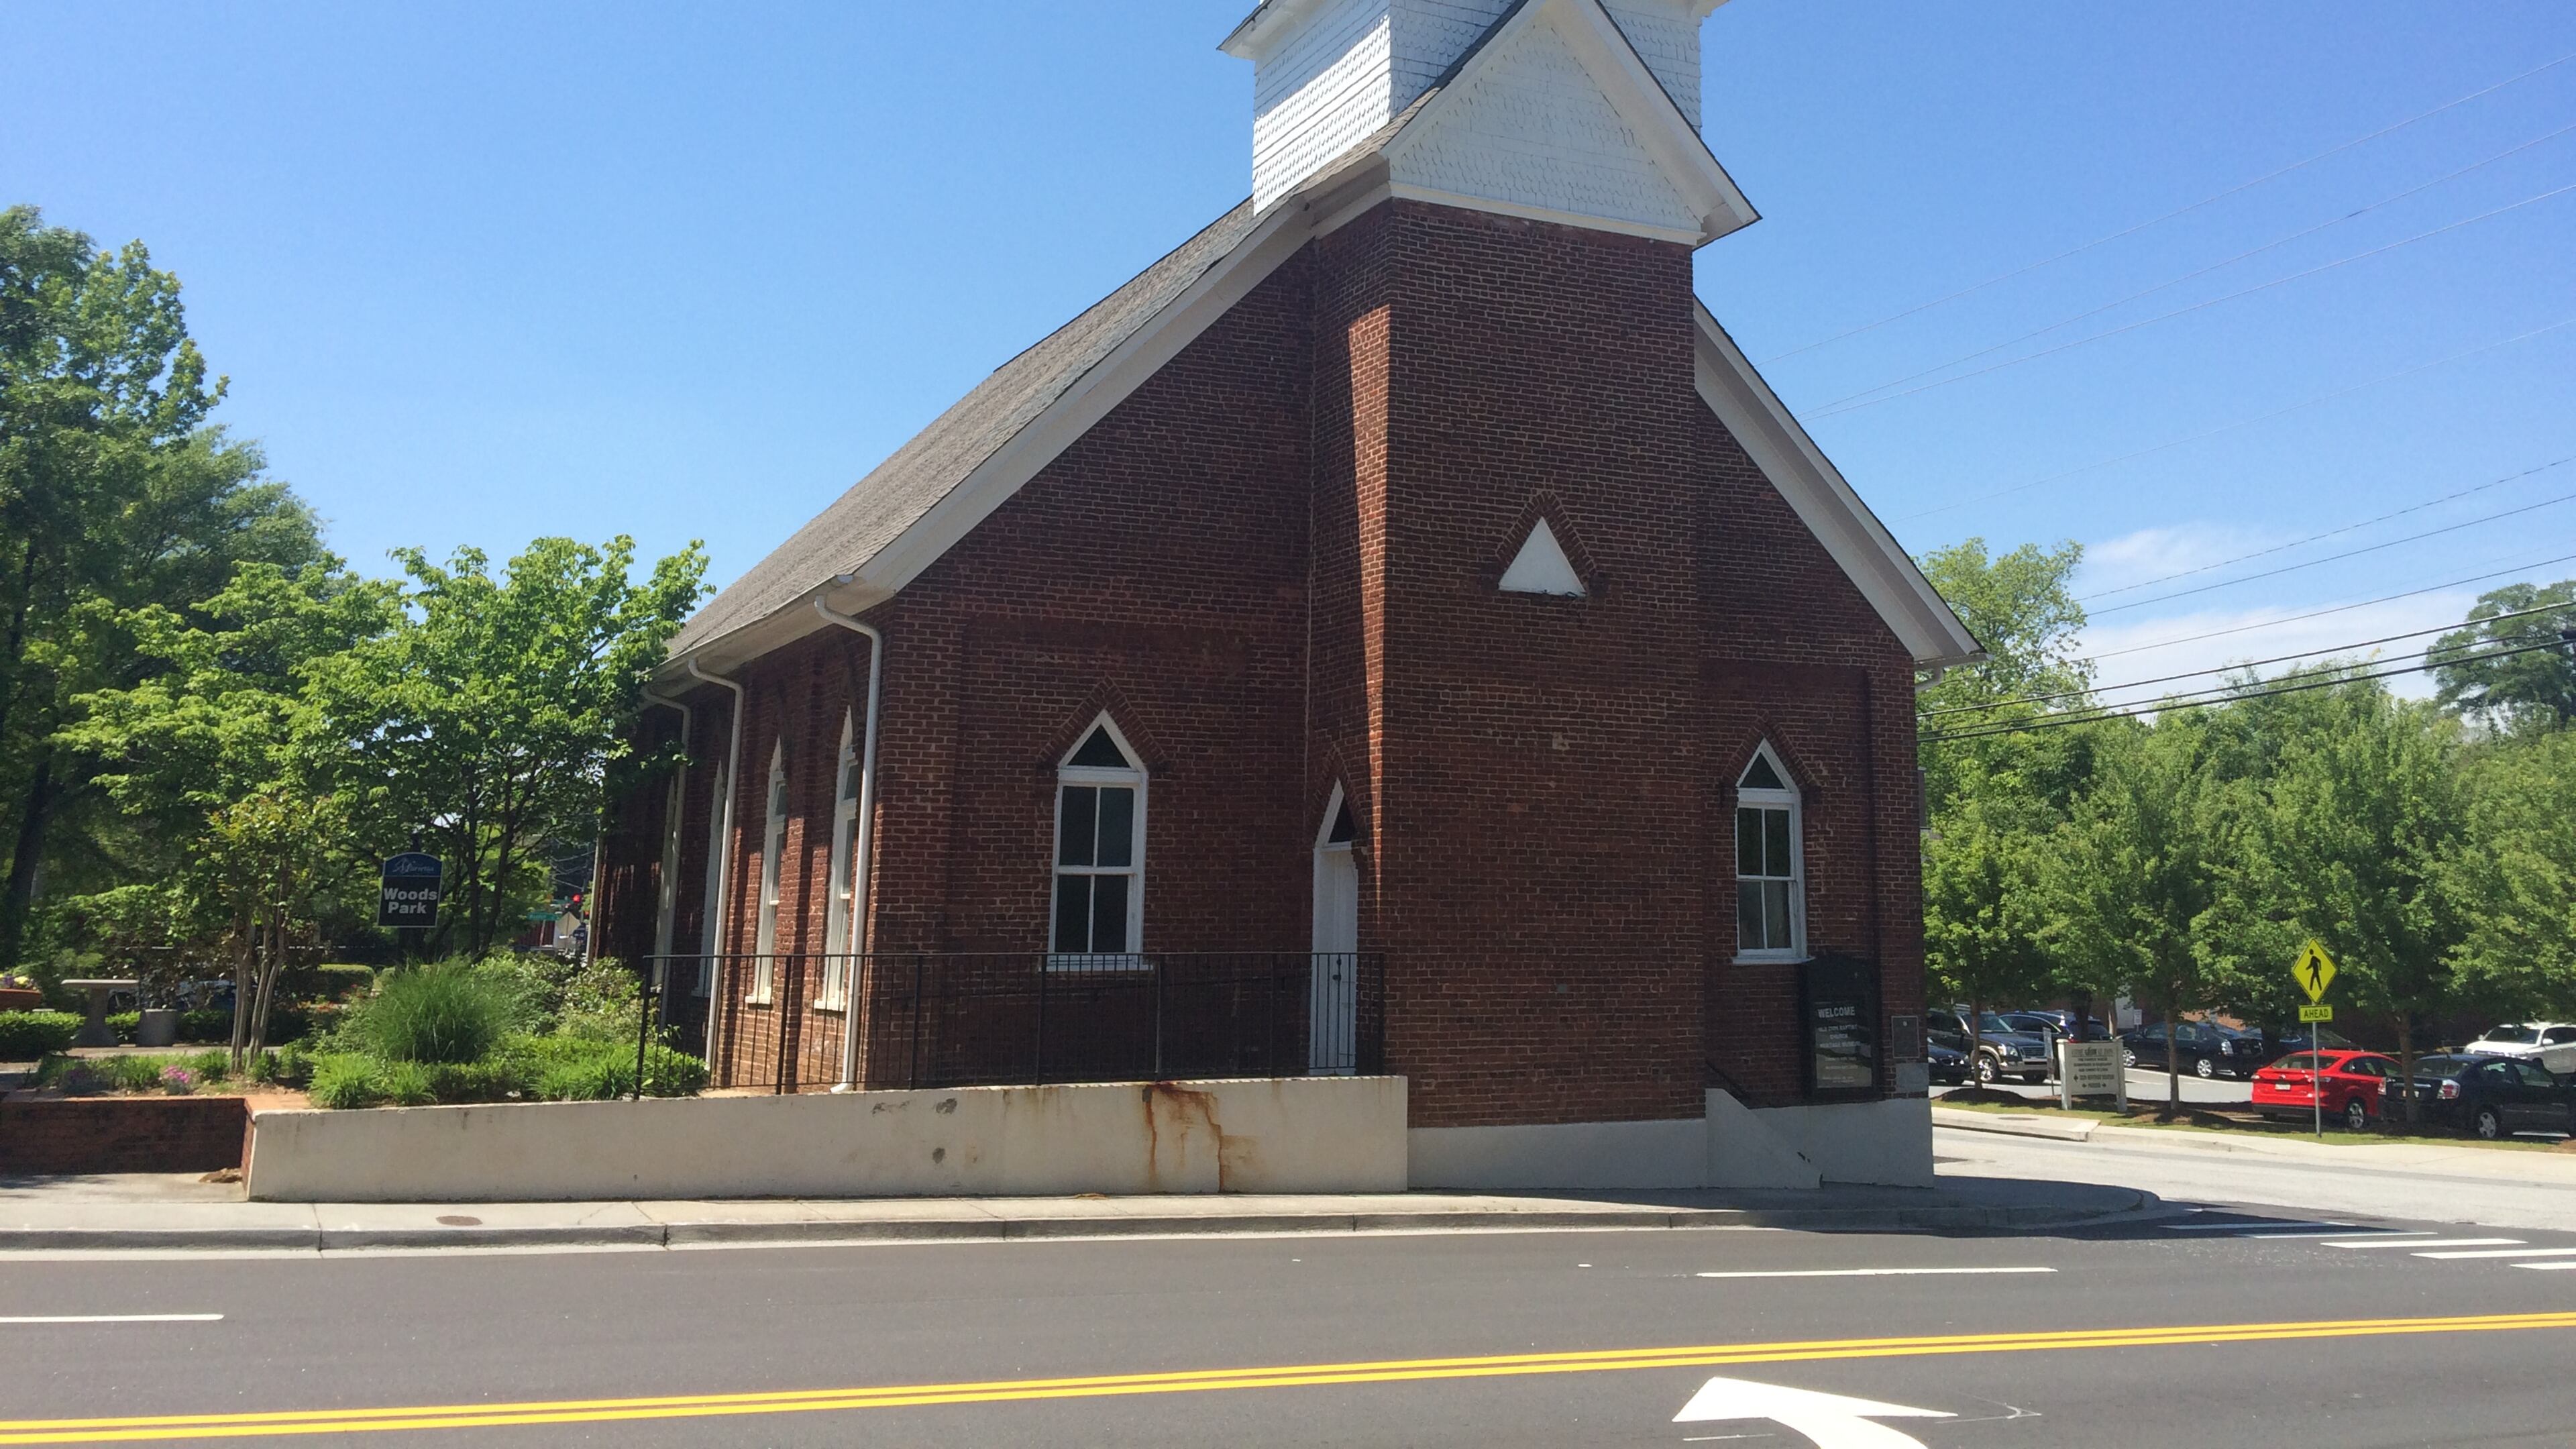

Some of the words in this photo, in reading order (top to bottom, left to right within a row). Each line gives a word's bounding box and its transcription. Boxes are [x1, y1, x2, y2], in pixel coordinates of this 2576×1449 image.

[384, 888, 437, 900] Woods
[388, 902, 427, 914] Park
[1817, 1006, 1856, 1018] WELCOME
[2304, 1008, 2328, 1018] AHEAD
